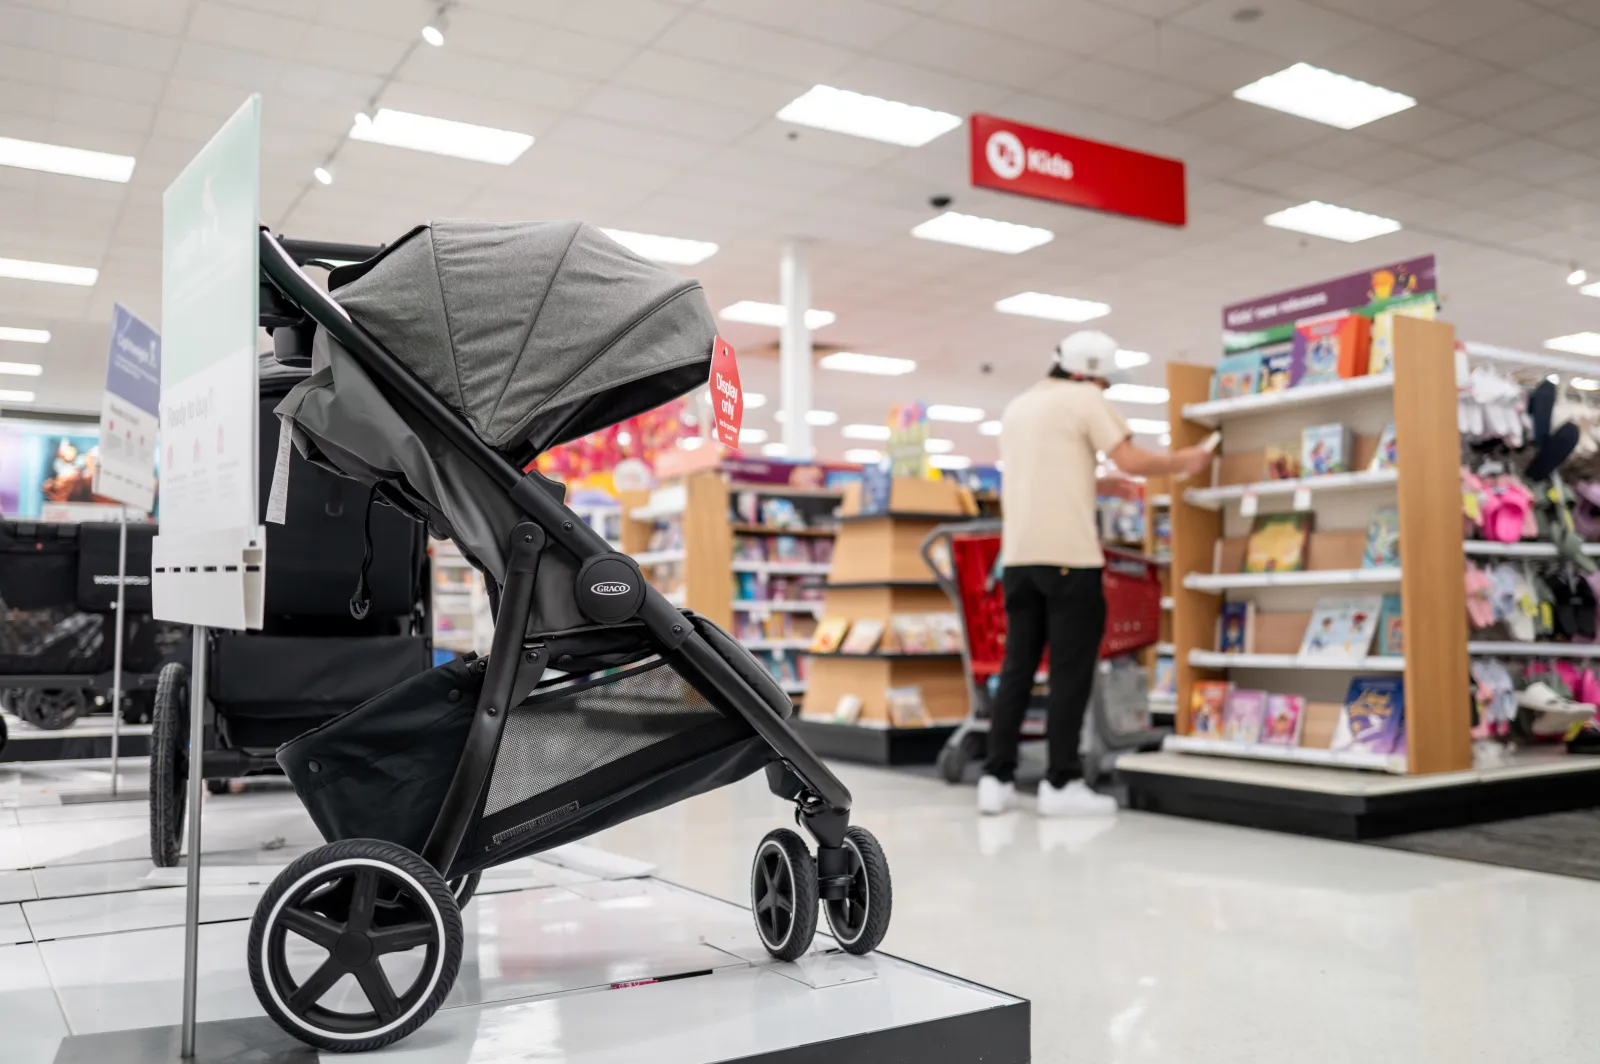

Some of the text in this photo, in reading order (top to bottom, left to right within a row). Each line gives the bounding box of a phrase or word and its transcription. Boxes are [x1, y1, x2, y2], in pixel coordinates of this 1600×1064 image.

[1026, 147, 1074, 180] Kids
[716, 372, 738, 404] Display
[167, 401, 186, 430] Ready
[187, 400, 195, 420] to
[721, 399, 734, 421] only
[93, 575, 150, 586] WONDRFOLD
